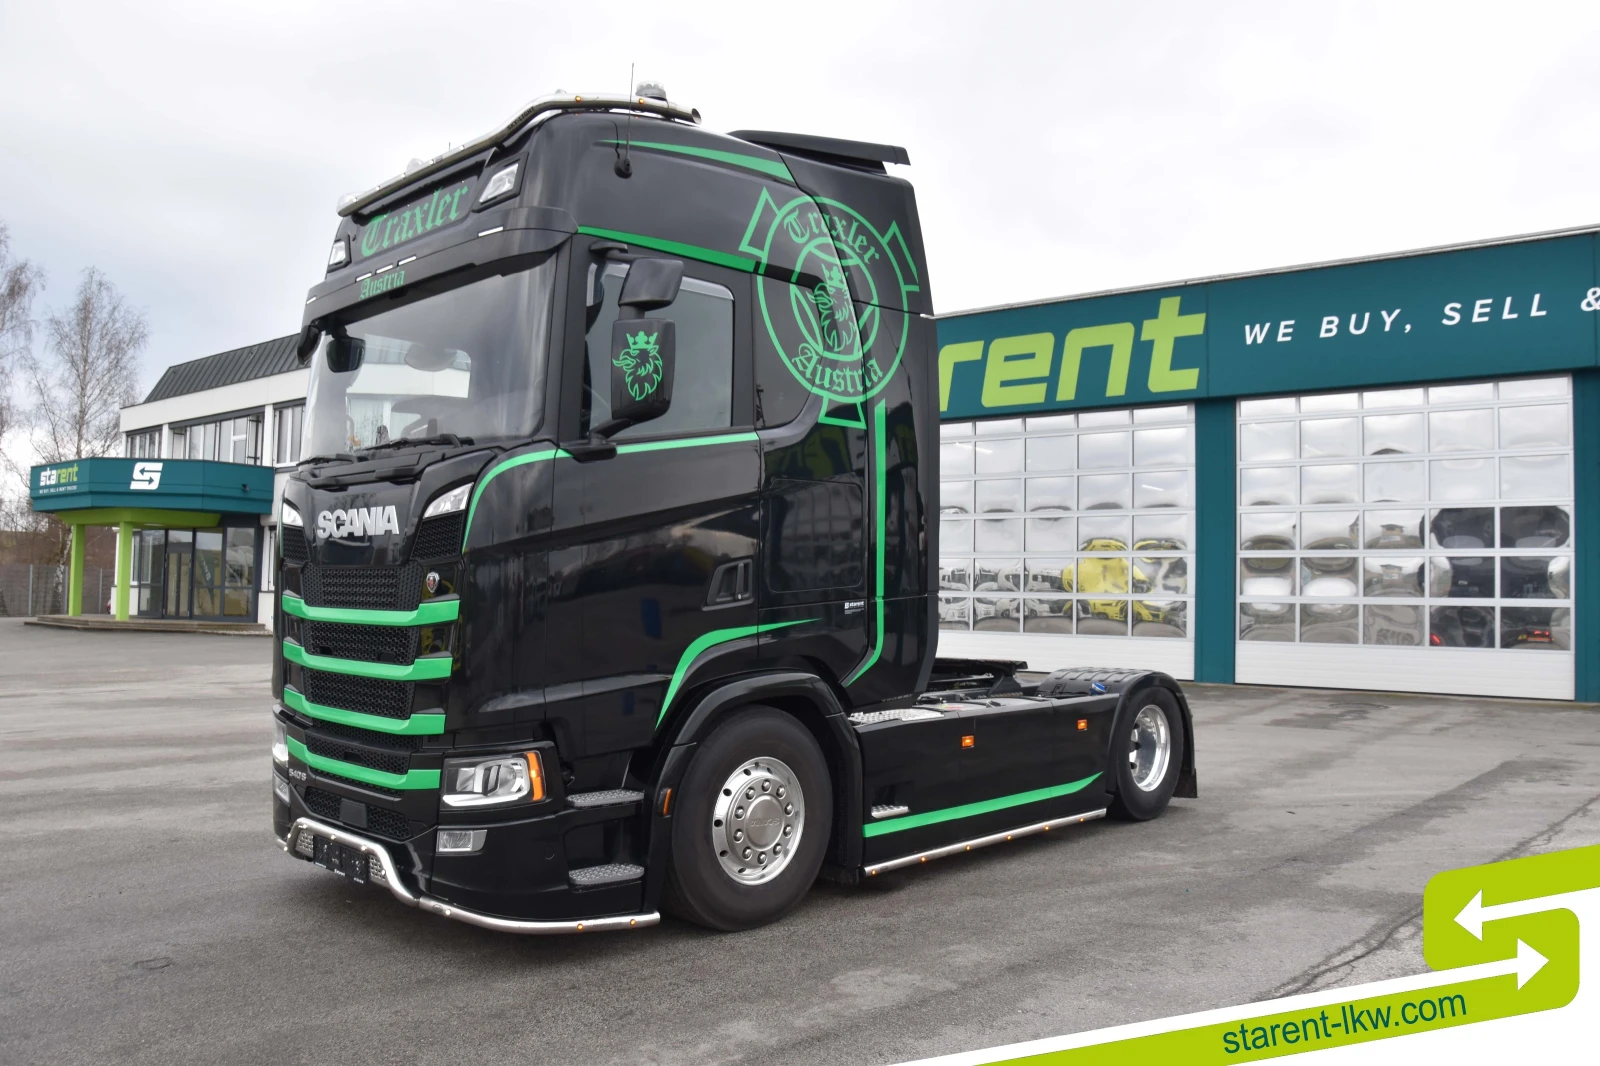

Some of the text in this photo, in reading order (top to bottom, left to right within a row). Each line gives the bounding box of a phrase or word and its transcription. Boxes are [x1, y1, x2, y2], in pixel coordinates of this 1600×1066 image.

[361, 186, 468, 257] Traxler
[784, 207, 880, 265] Traxler
[359, 270, 405, 301] Austria
[1244, 286, 1600, 346] WE BUY, SELL &
[792, 343, 883, 394] Austria
[40, 463, 79, 486] starent
[317, 504, 400, 539] SCANIA
